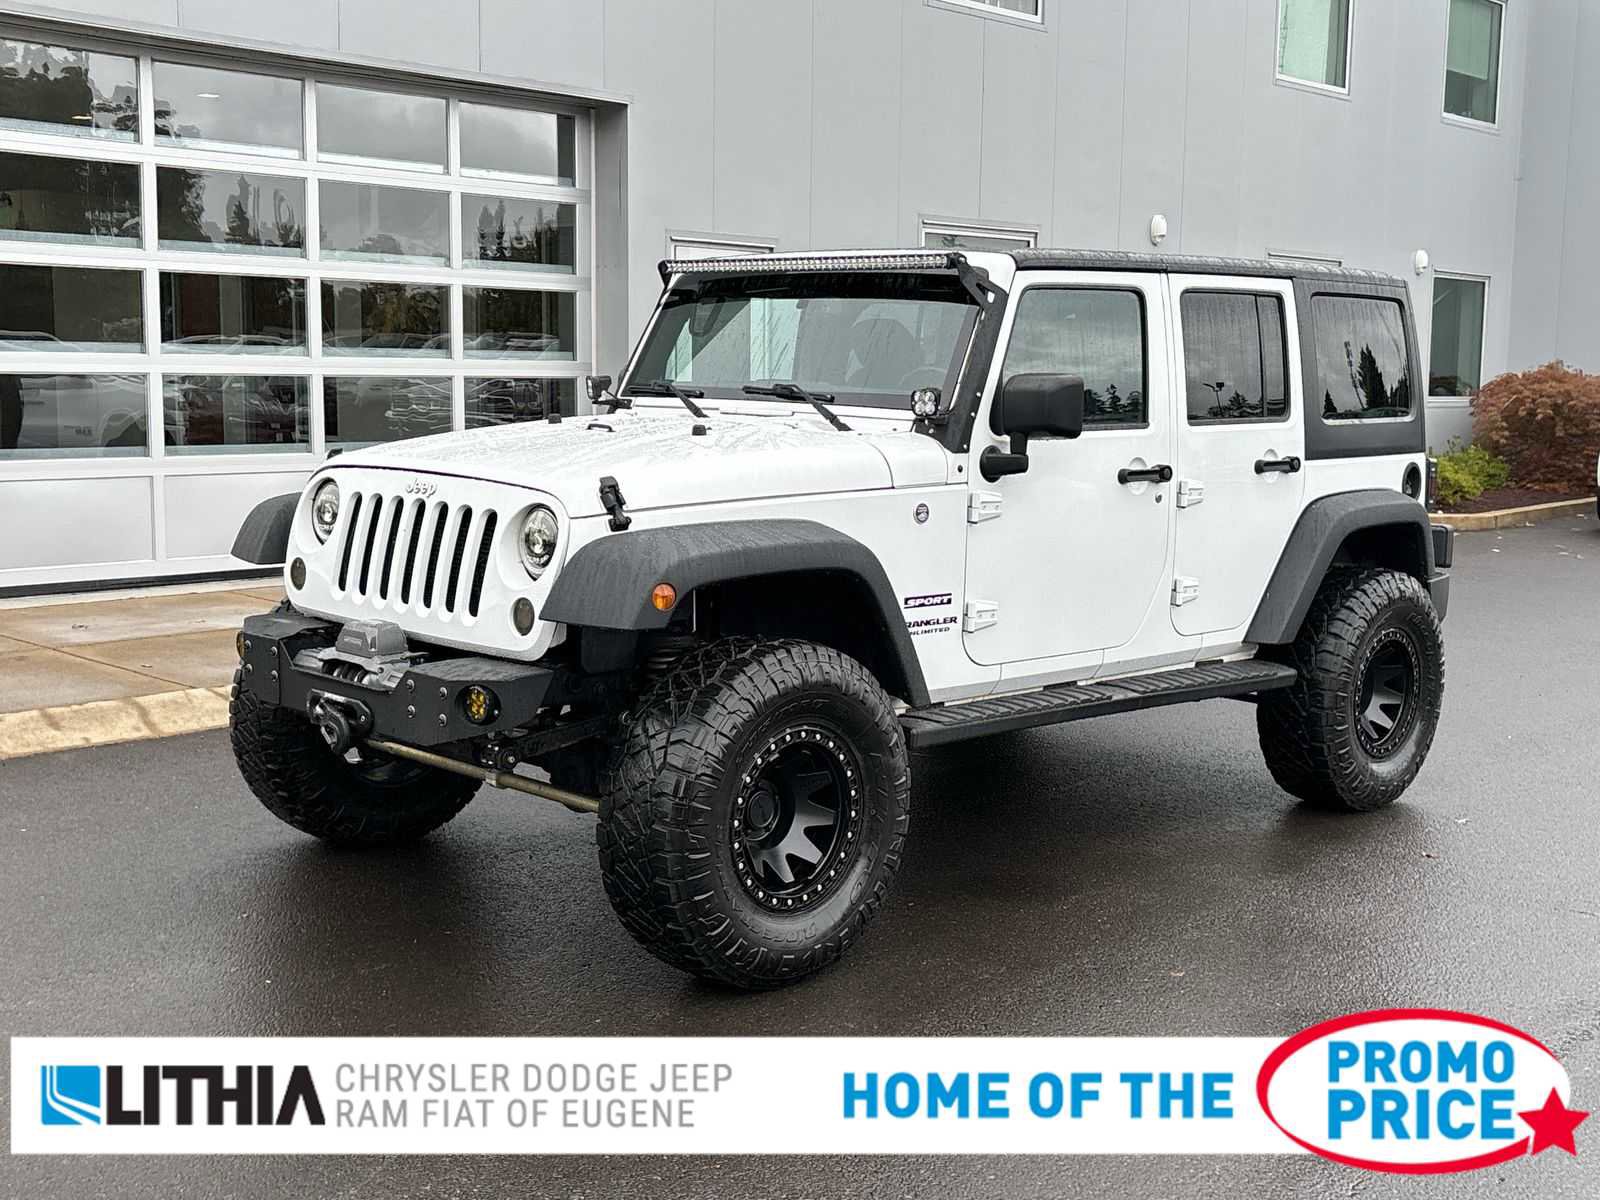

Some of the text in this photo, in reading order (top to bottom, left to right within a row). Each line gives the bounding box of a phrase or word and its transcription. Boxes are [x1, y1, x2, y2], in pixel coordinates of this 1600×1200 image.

[405, 478, 438, 499] Jeep
[905, 596, 950, 607] SPORT
[904, 616, 958, 628] RANGLER
[910, 627, 951, 636] NLIMITED
